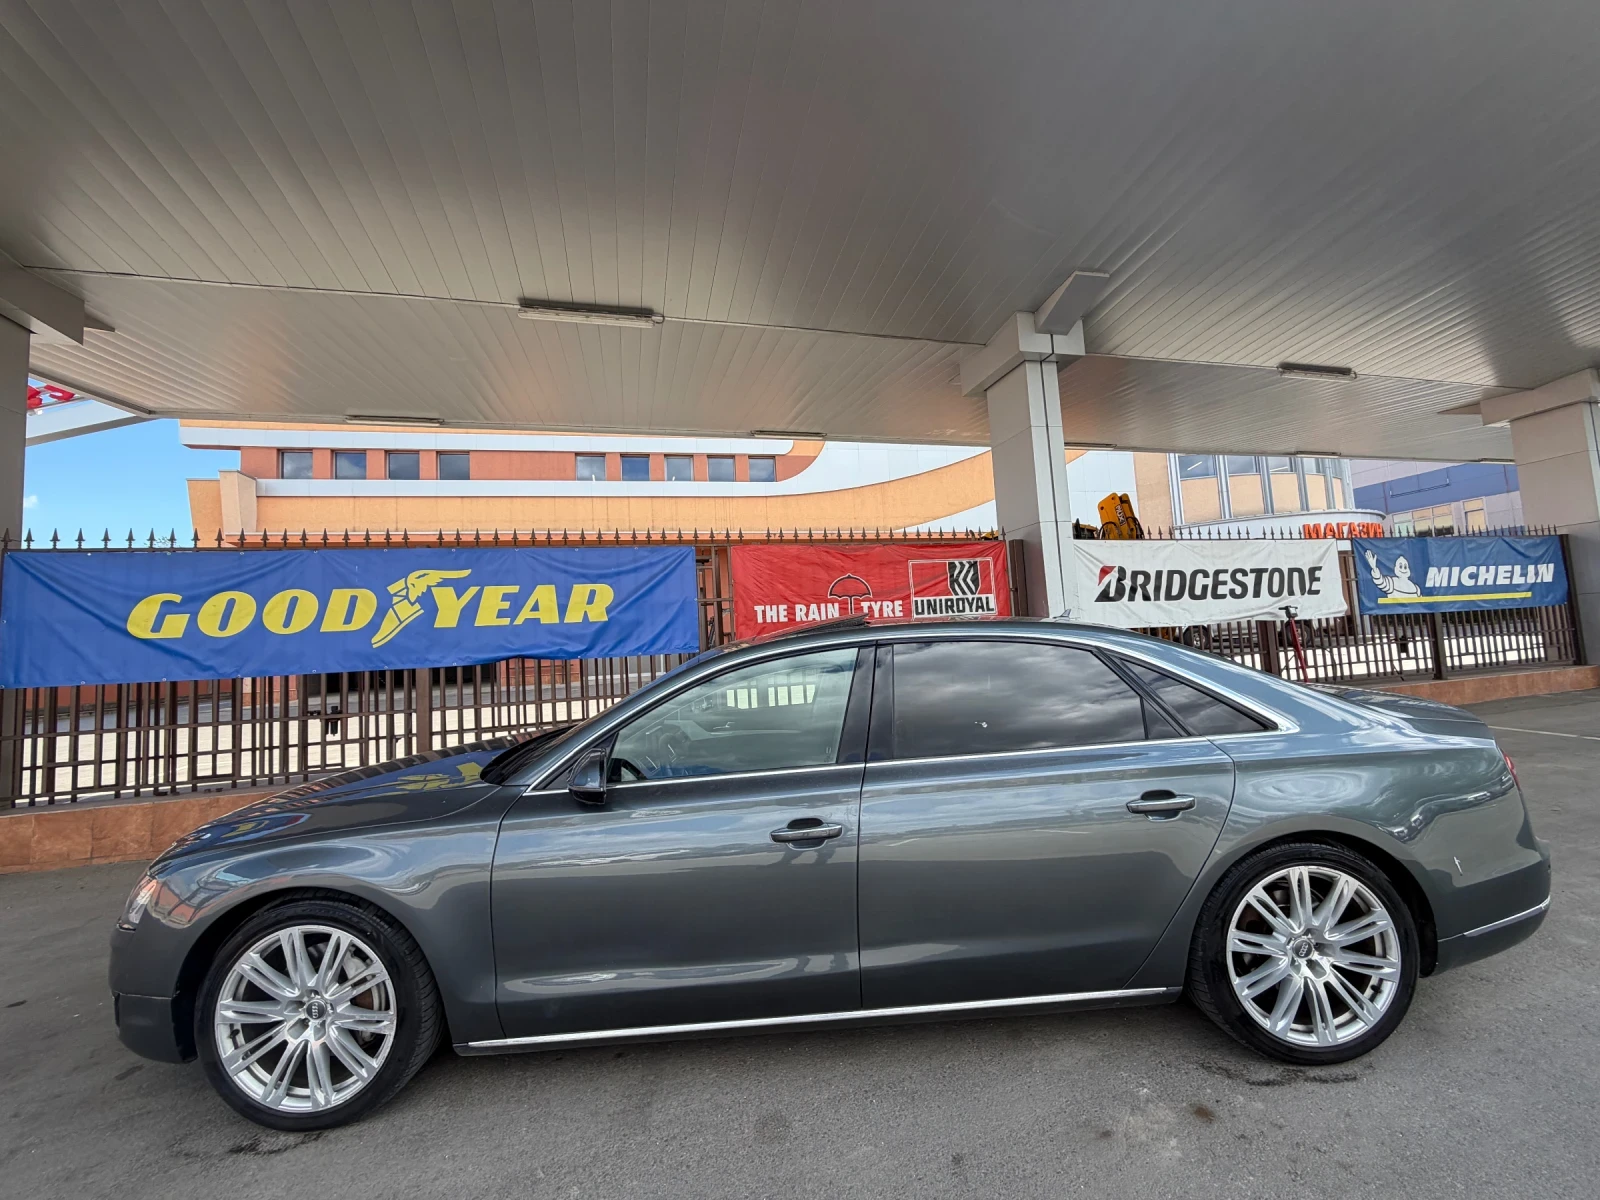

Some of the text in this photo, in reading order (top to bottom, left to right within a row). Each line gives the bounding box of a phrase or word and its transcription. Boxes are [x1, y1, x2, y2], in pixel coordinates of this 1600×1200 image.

[1302, 522, 1383, 539] МАГАЗИН
[1094, 565, 1323, 603] BRIDGESTONE
[1425, 563, 1555, 588] MICHELIN
[754, 600, 903, 623] THE RAIN TYRE
[914, 596, 995, 615] UNIROYAL
